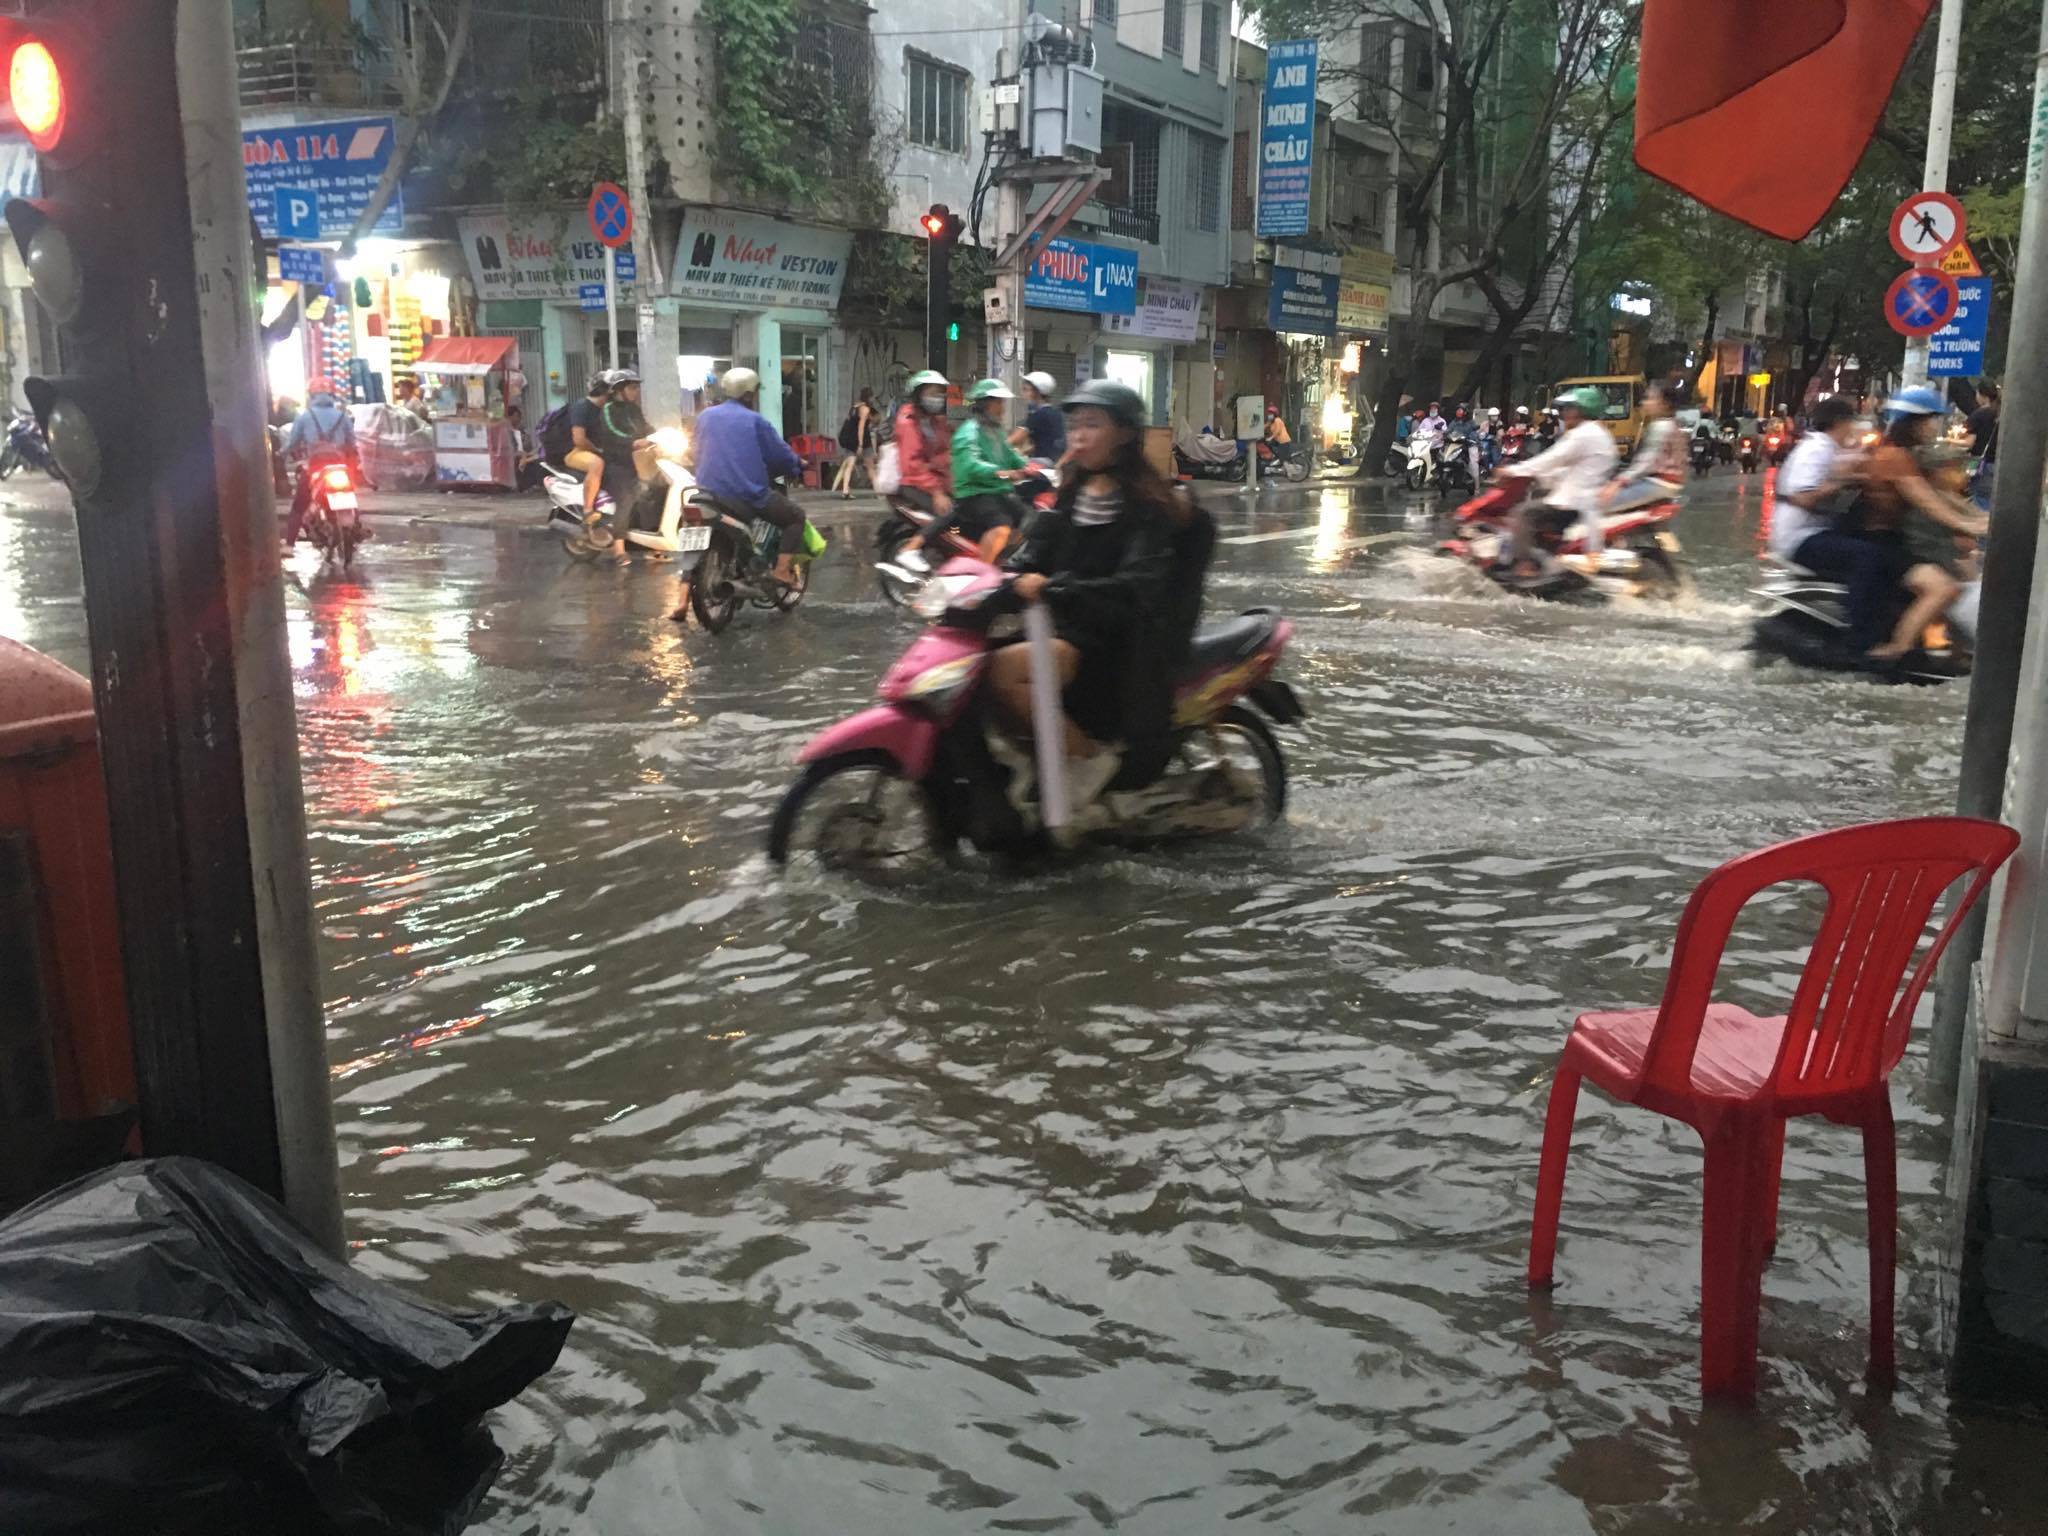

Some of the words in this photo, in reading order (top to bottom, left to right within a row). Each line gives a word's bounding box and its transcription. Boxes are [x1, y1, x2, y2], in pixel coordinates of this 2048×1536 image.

[1273, 65, 1307, 88] ANH
[1267, 103, 1306, 126] MINH
[296, 134, 339, 160] 114
[1265, 134, 1308, 163] CHÂU
[290, 199, 309, 227] P
[780, 255, 838, 276] VESTON
[1039, 245, 1088, 283] PHÚC
[1107, 261, 1134, 288] INAX
[685, 269, 710, 283] MAY
[1148, 294, 1168, 310] MINH
[1930, 357, 1963, 369] WORKS
